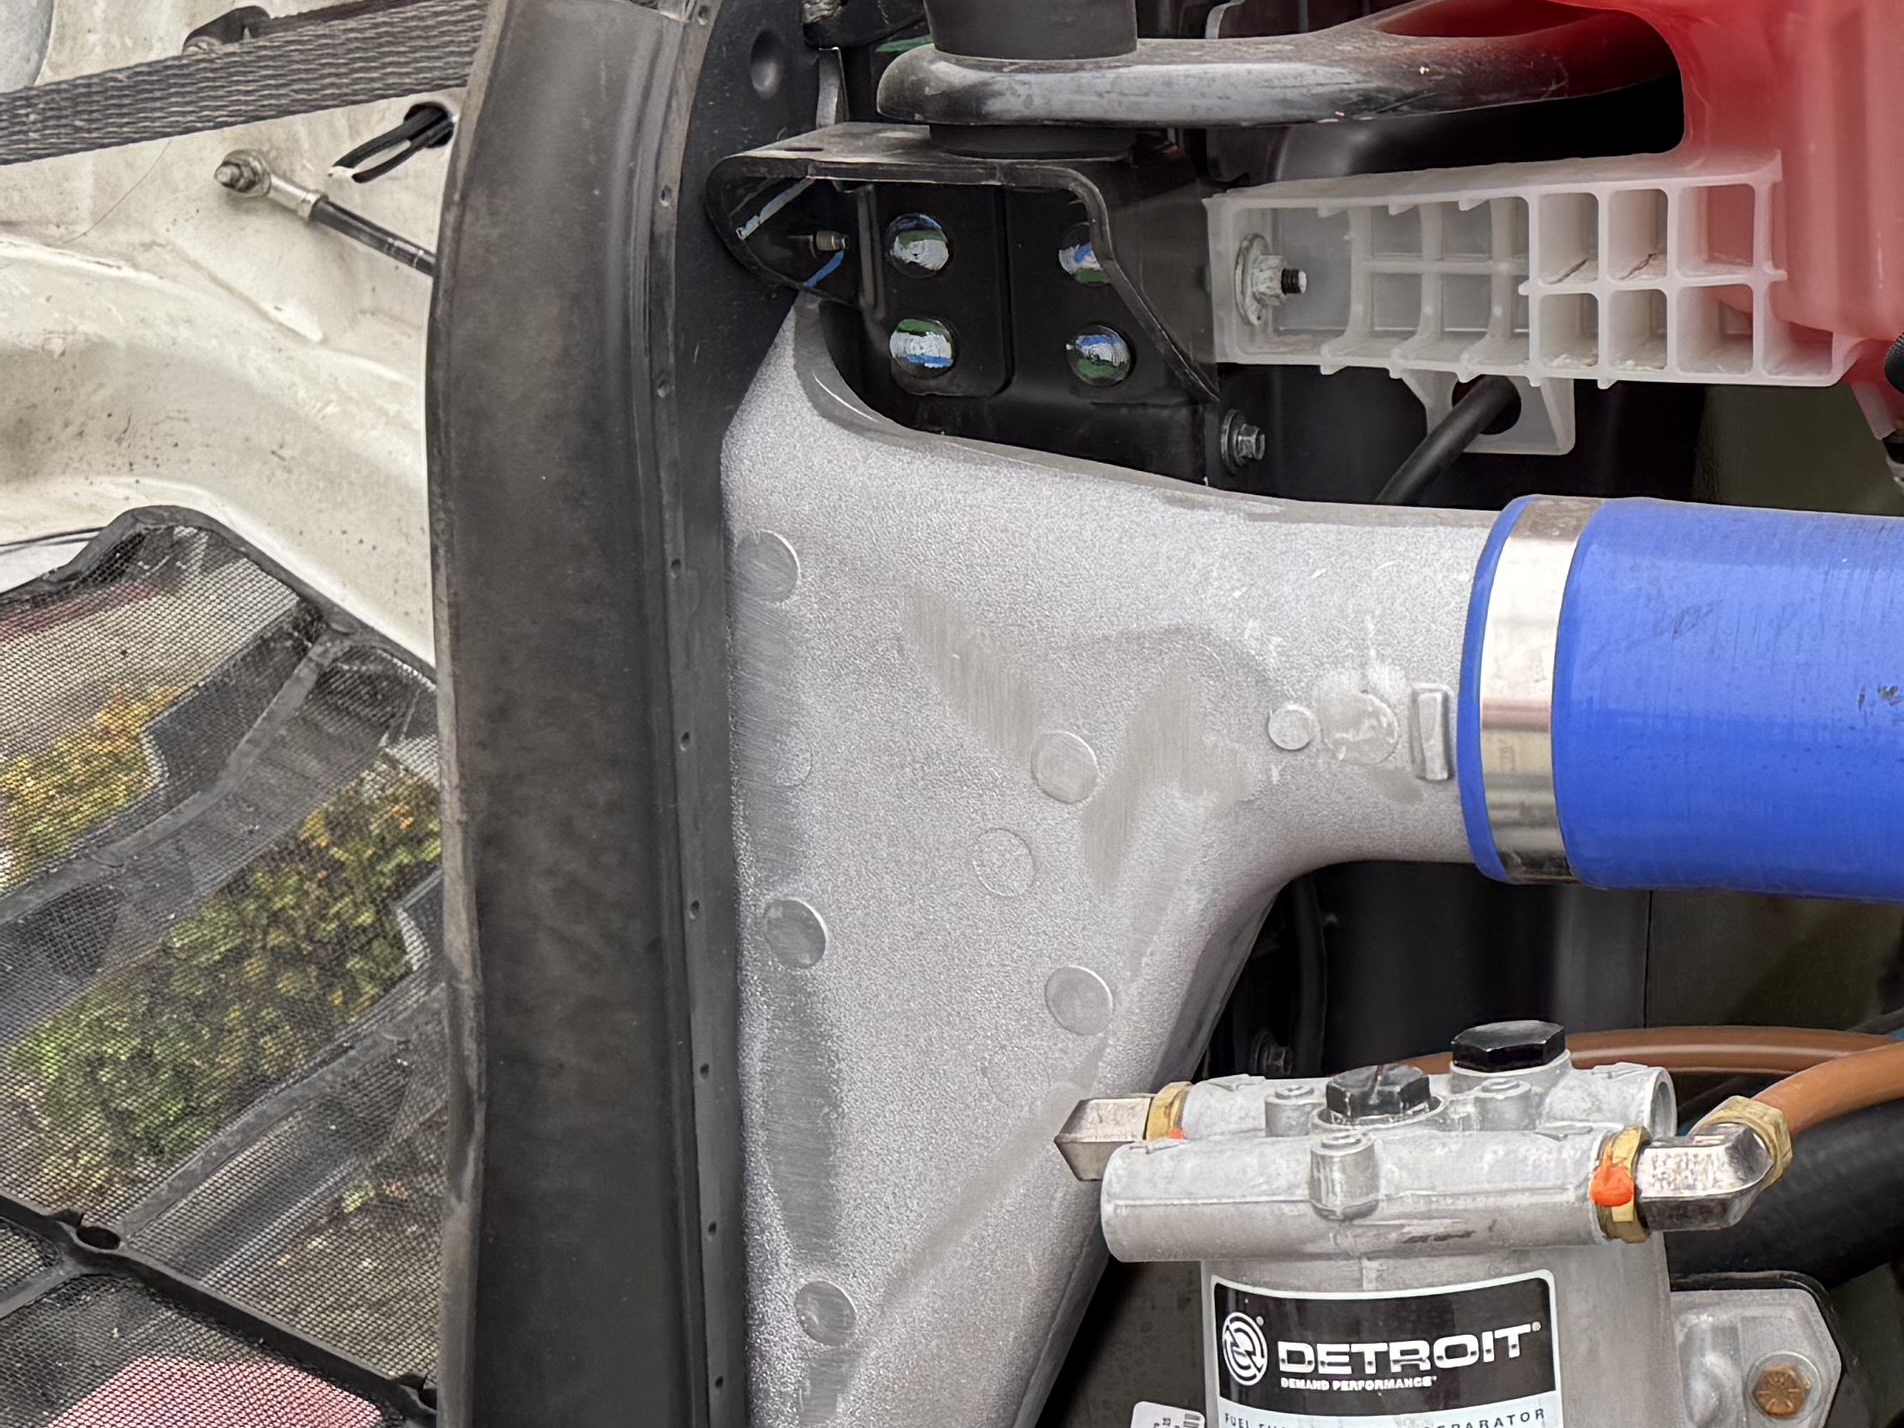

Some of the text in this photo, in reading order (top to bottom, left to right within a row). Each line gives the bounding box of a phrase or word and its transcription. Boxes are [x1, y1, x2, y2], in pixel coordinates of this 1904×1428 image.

[1278, 1324, 1531, 1374] DETROIT
[1280, 1376, 1434, 1391] DEMAND PERFORMANCE
